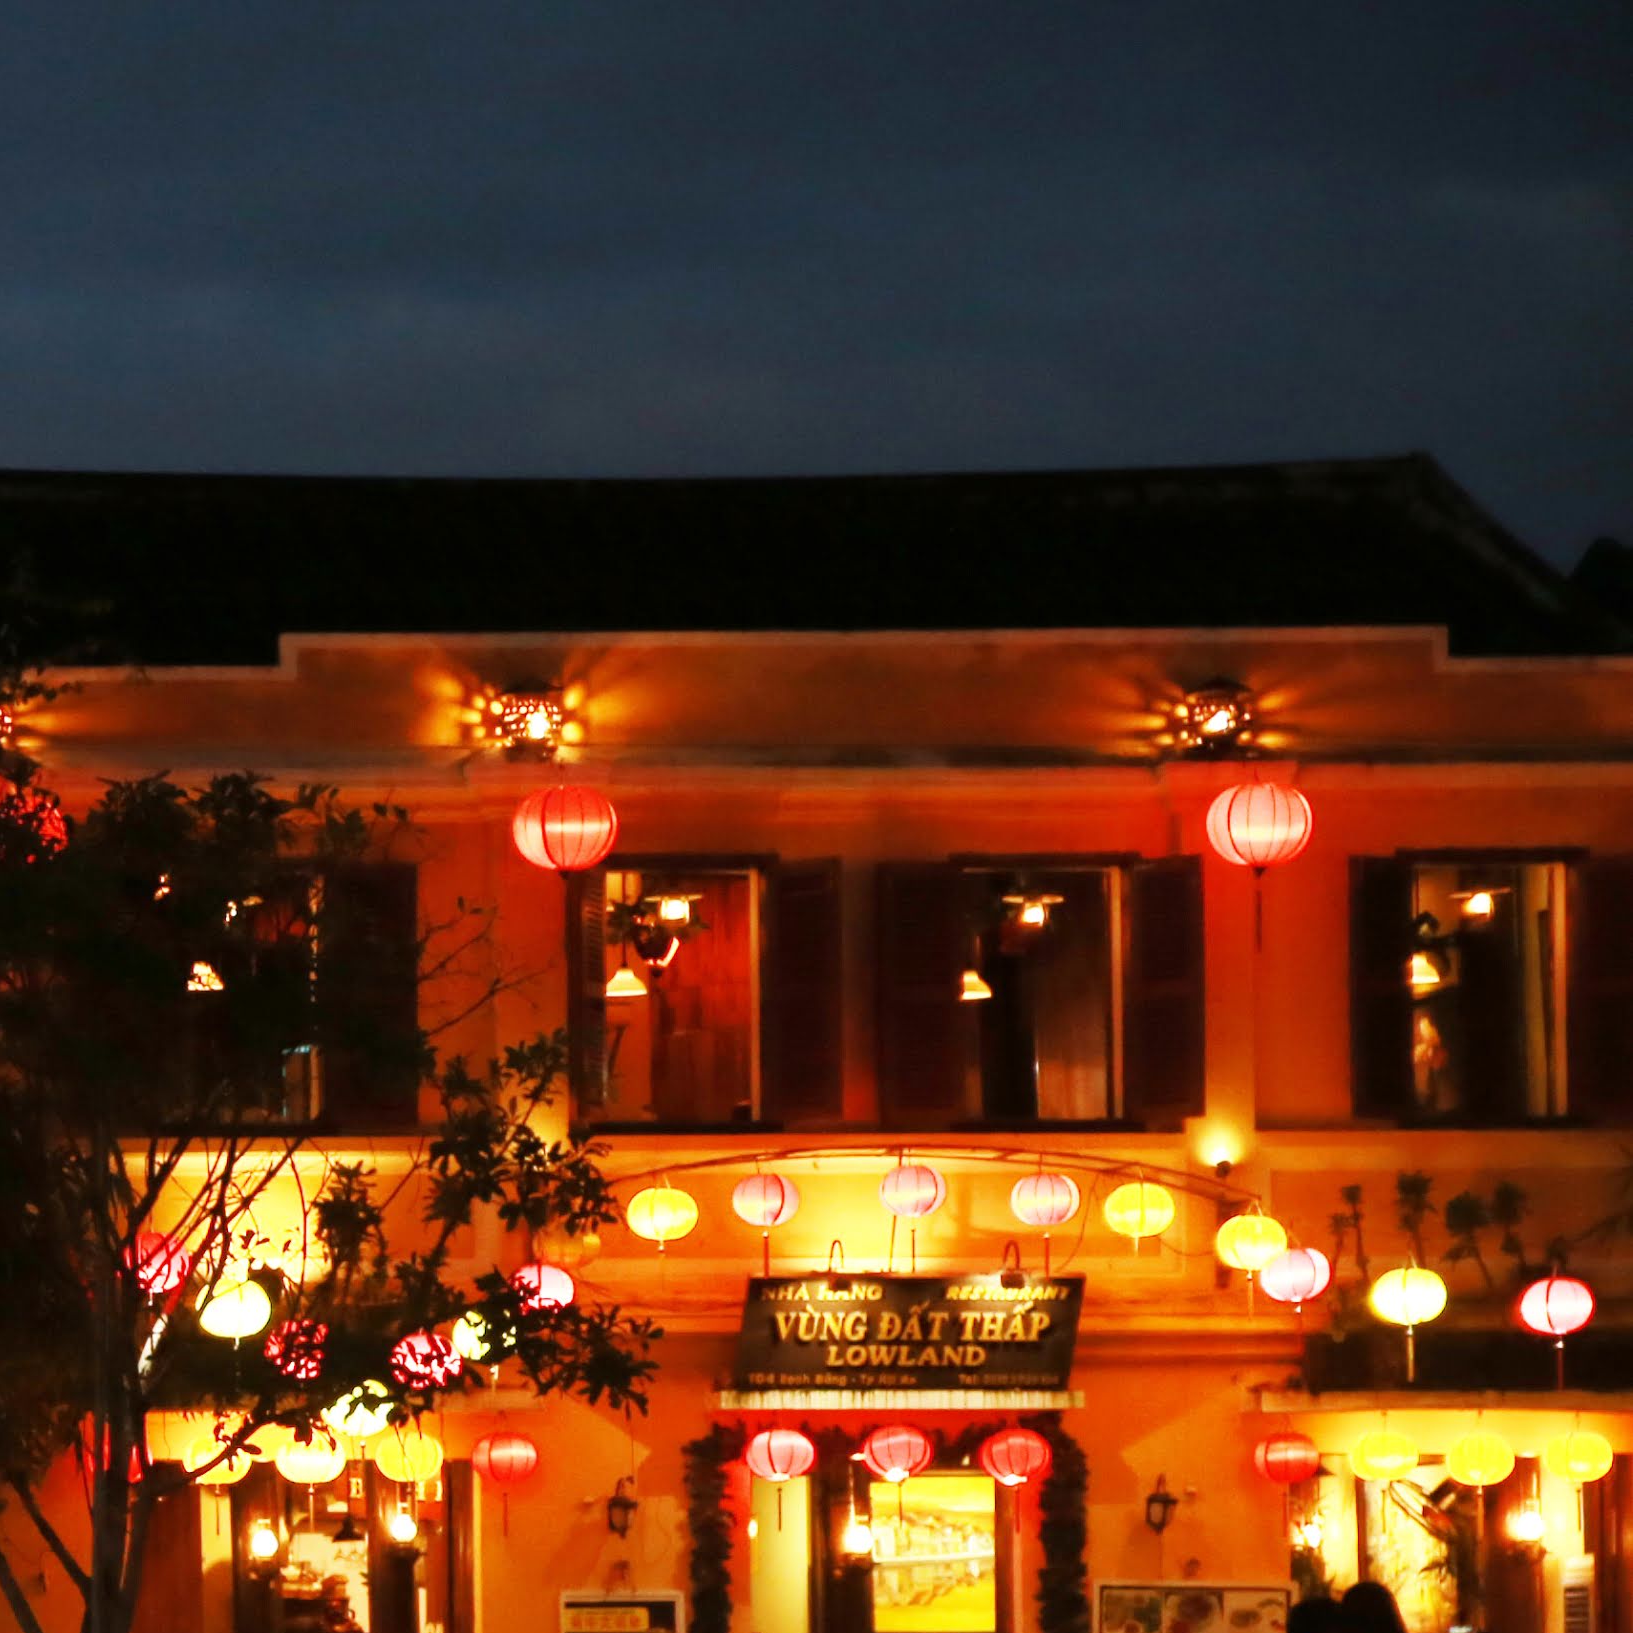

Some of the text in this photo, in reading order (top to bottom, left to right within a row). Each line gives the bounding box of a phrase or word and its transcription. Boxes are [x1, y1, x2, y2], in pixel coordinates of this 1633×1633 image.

[774, 1300, 1052, 1342] VÙNG ĐẤT THẤP
[825, 1344, 987, 1368] LOWLAND
